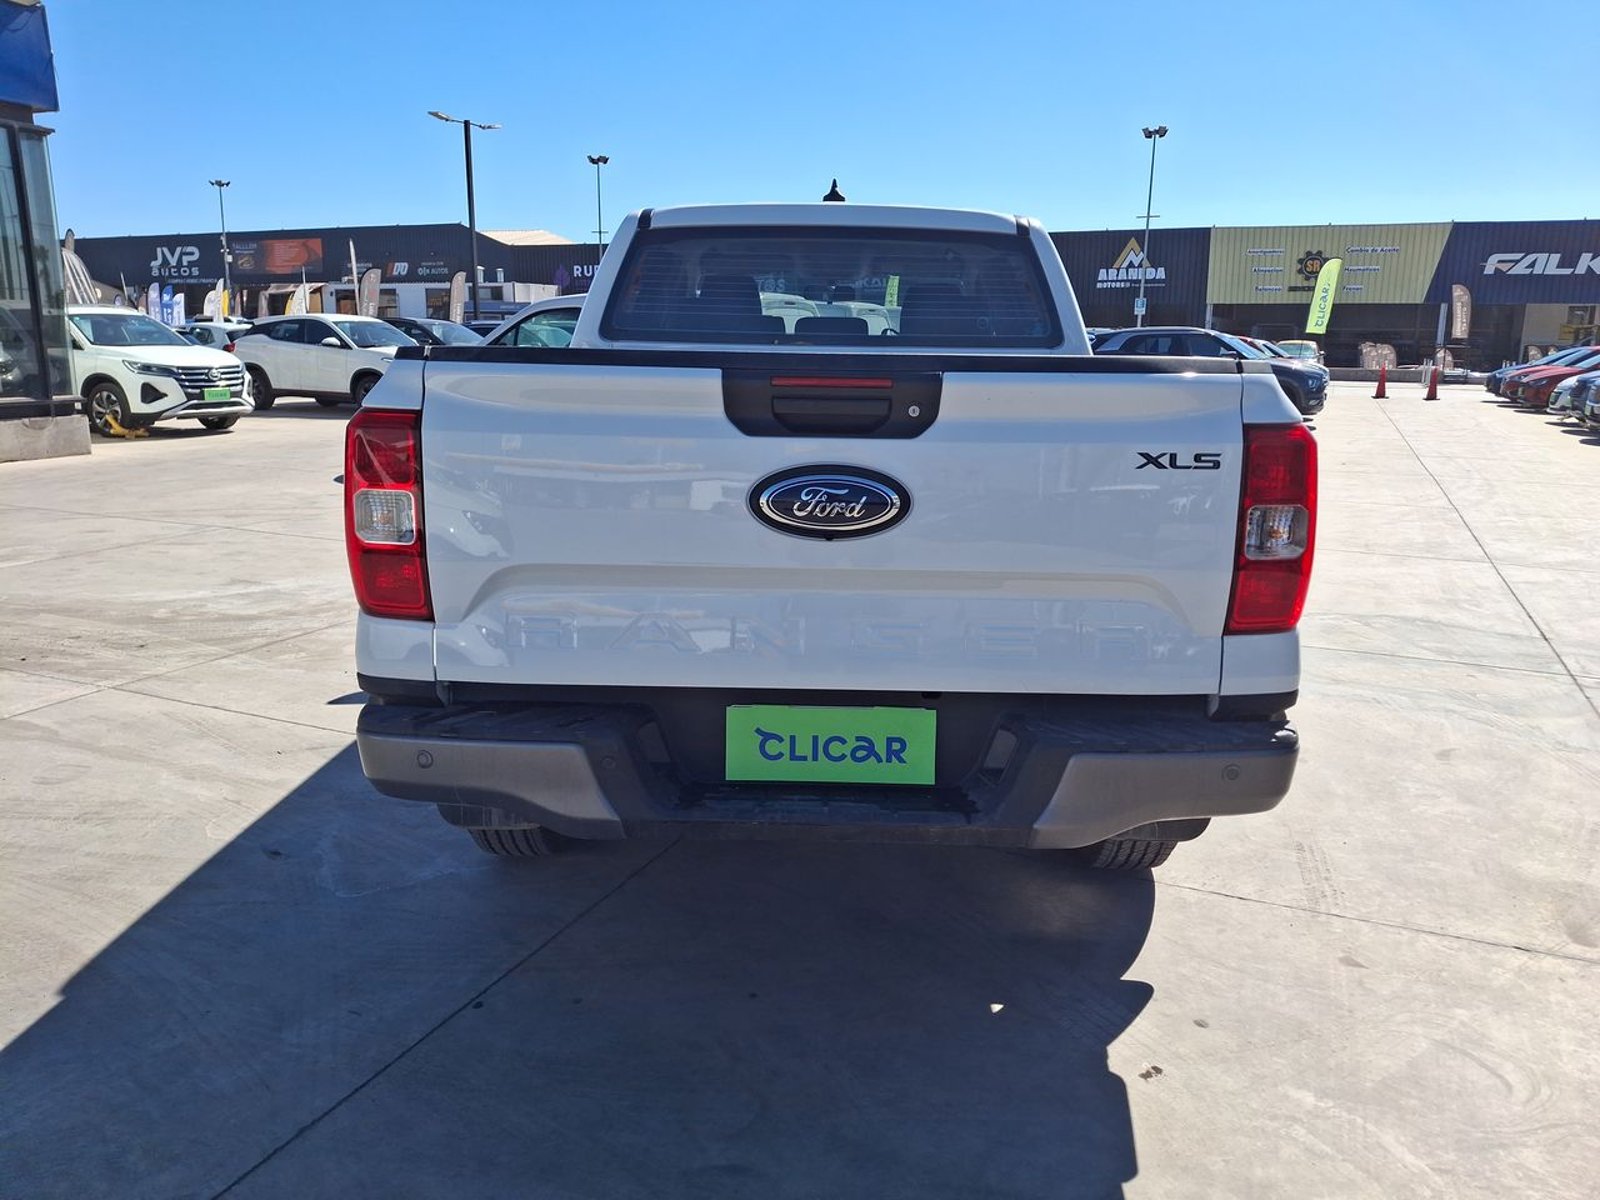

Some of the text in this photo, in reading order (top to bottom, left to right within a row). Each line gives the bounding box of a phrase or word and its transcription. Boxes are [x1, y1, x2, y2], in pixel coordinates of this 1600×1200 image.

[150, 246, 200, 267] JVP
[1135, 452, 1222, 469] XLS
[793, 486, 868, 517] Ford
[754, 727, 907, 764] CLICAR
